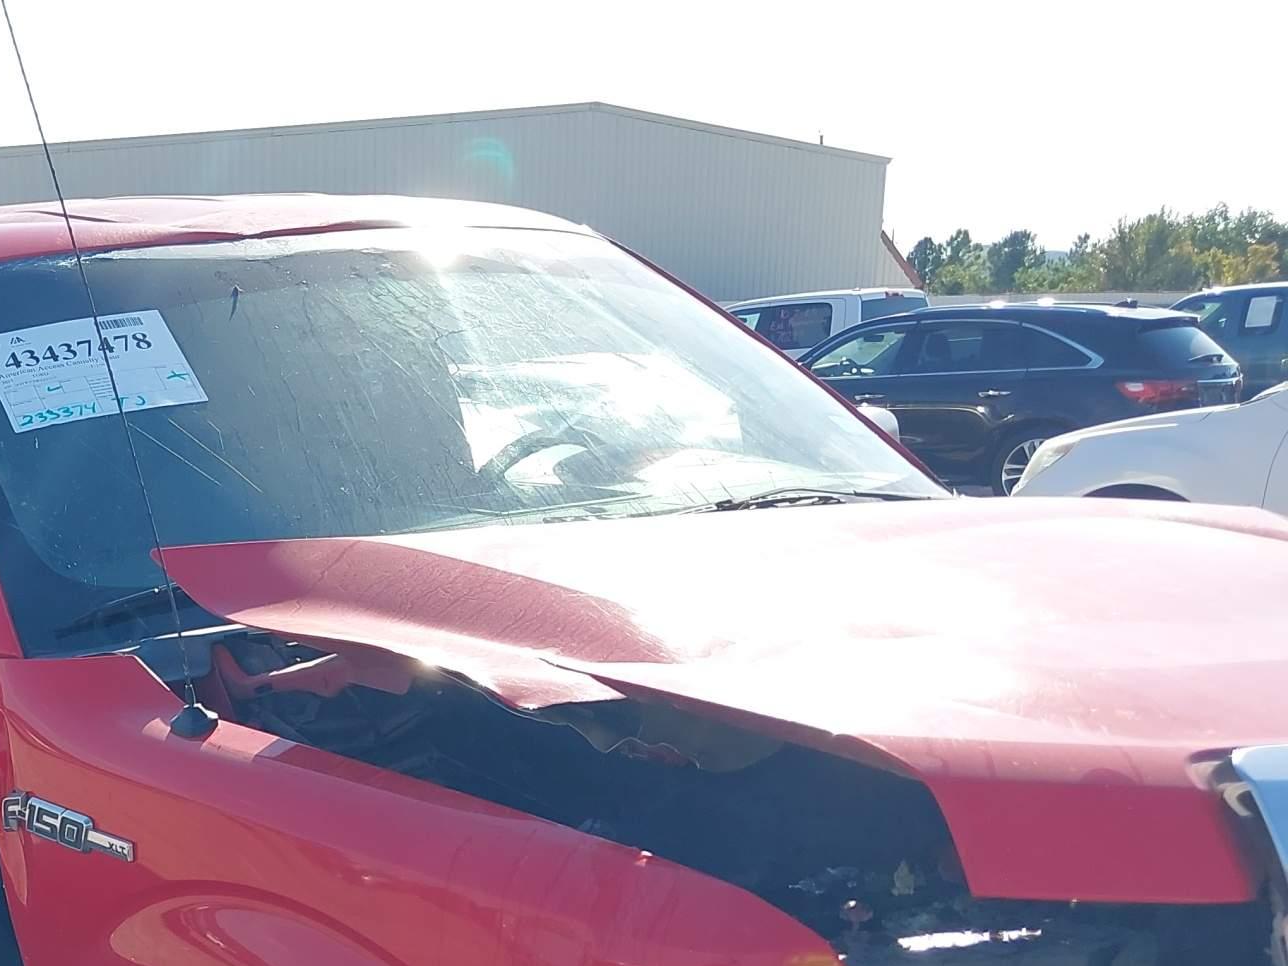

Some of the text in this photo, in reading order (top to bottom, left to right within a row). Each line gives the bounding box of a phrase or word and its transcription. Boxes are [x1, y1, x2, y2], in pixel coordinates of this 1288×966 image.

[5, 332, 152, 369] 43437478
[2, 791, 127, 854] F-150 XLT
